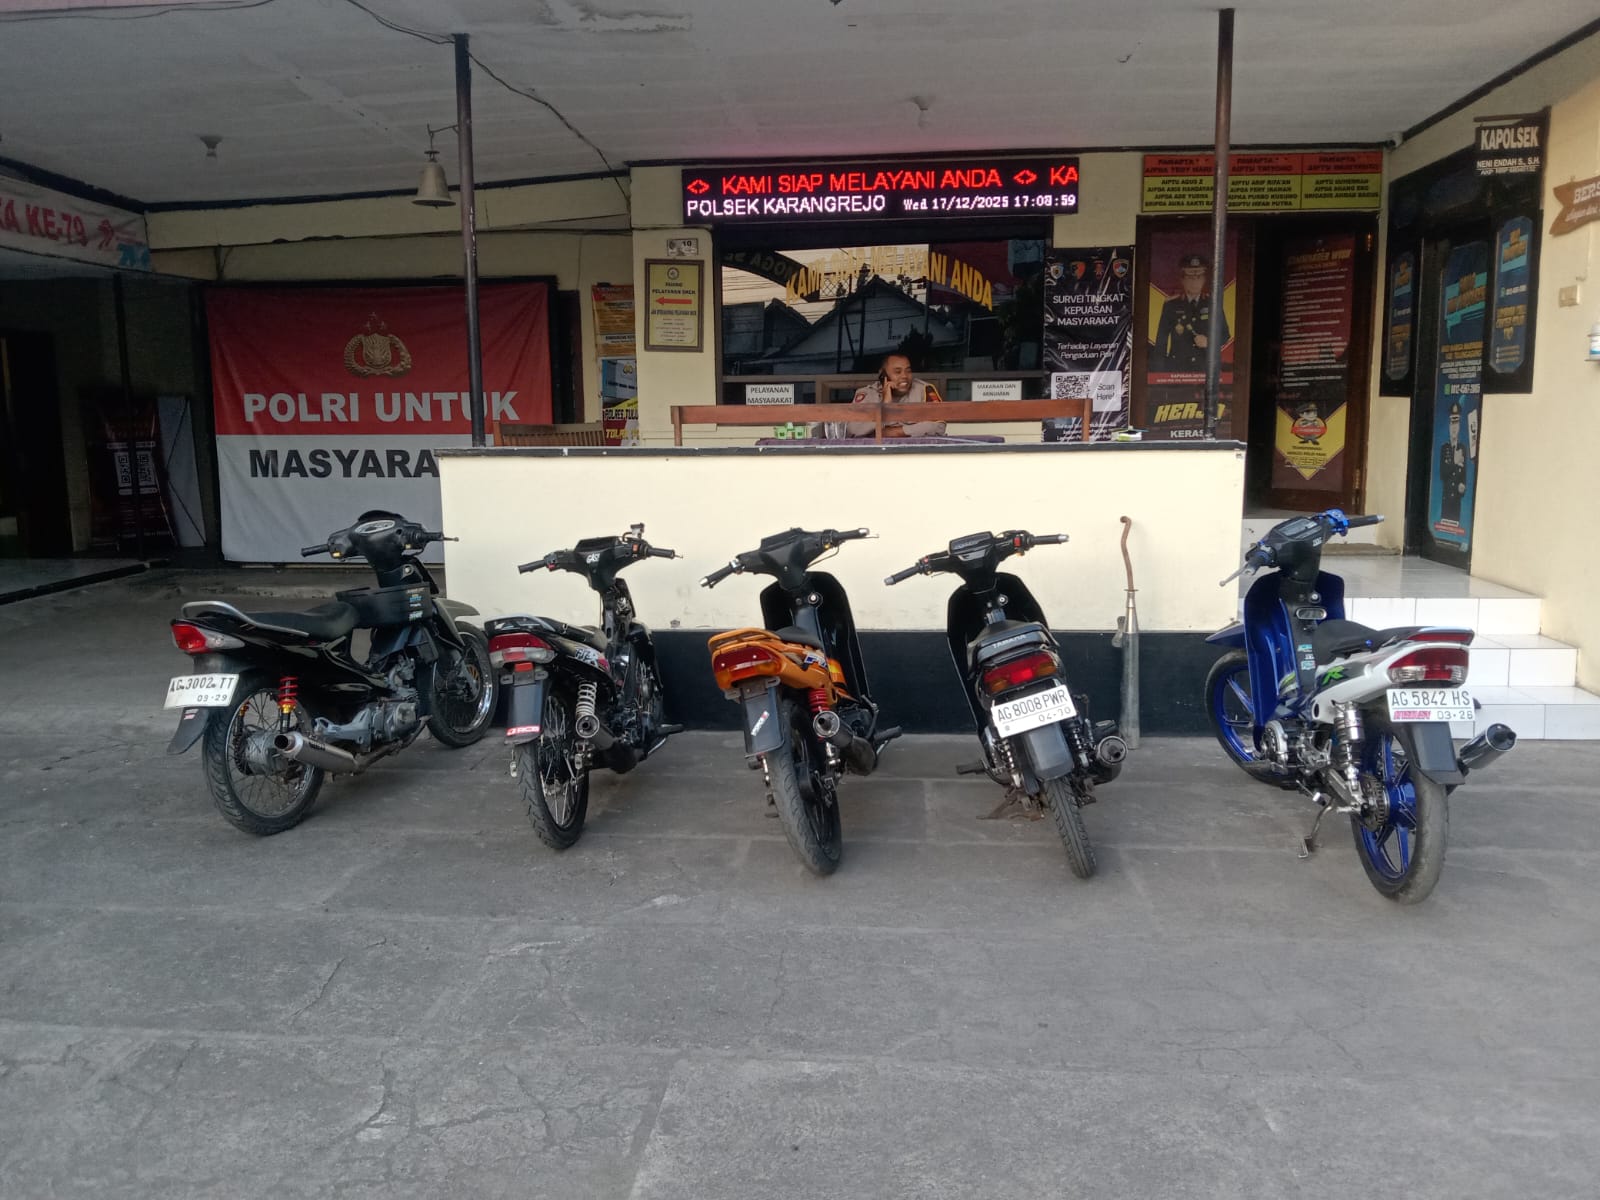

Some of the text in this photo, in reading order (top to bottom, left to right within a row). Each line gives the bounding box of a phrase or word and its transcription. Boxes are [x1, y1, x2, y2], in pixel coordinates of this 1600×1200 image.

[1481, 127, 1540, 150] KAPOLSEK
[1476, 160, 1493, 169] NENI
[1494, 158, 1517, 167] ENDAH
[721, 174, 772, 195] KAMI
[778, 173, 823, 193] SIAP
[829, 170, 935, 192] MELAYANI
[940, 169, 1003, 189] ANDA
[687, 198, 760, 217] POLSEK
[764, 195, 886, 215] KARANGREJO
[903, 198, 929, 211] Wed
[932, 195, 1009, 211] 17/12/2025
[949, 258, 993, 313] ANDA
[1053, 293, 1125, 304] SURVEI TINGKAT
[1064, 305, 1113, 315] KEPUASAN
[1057, 316, 1120, 326] MASYARAKAT
[750, 387, 790, 395] PELAYANAN
[243, 393, 360, 422] POLRI
[185, 677, 214, 690] 3002
[219, 677, 235, 689] TT
[997, 689, 1068, 722] AG 8008 PWR
[1391, 690, 1471, 706] AG 5842 HS
